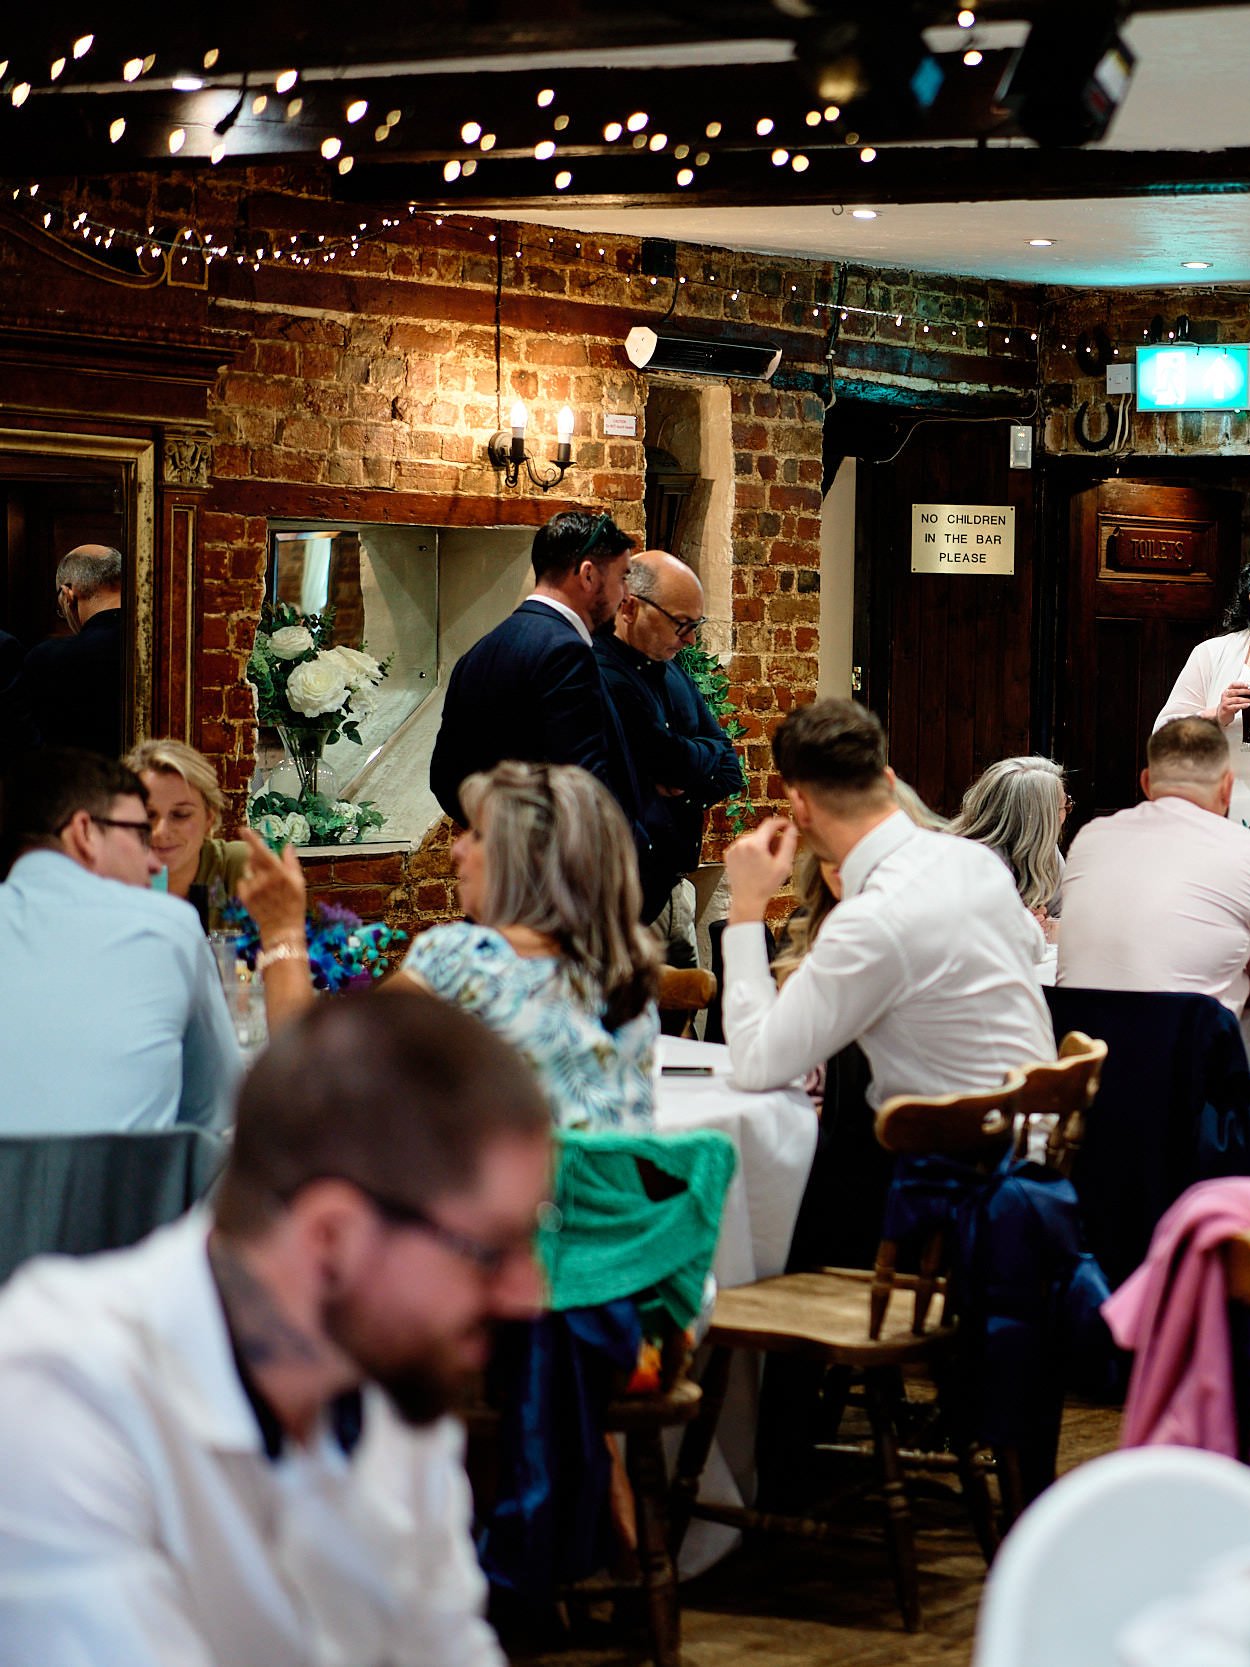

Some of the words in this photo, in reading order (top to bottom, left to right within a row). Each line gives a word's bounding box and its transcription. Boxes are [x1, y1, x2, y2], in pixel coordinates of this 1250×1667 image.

[921, 513, 938, 523] NO
[947, 514, 1006, 525] CHILDREN
[924, 533, 936, 543] IN
[944, 533, 968, 544] THE
[976, 534, 1002, 545] BAR
[1130, 538, 1184, 561] TOILETS
[939, 552, 987, 563] PLEASE
